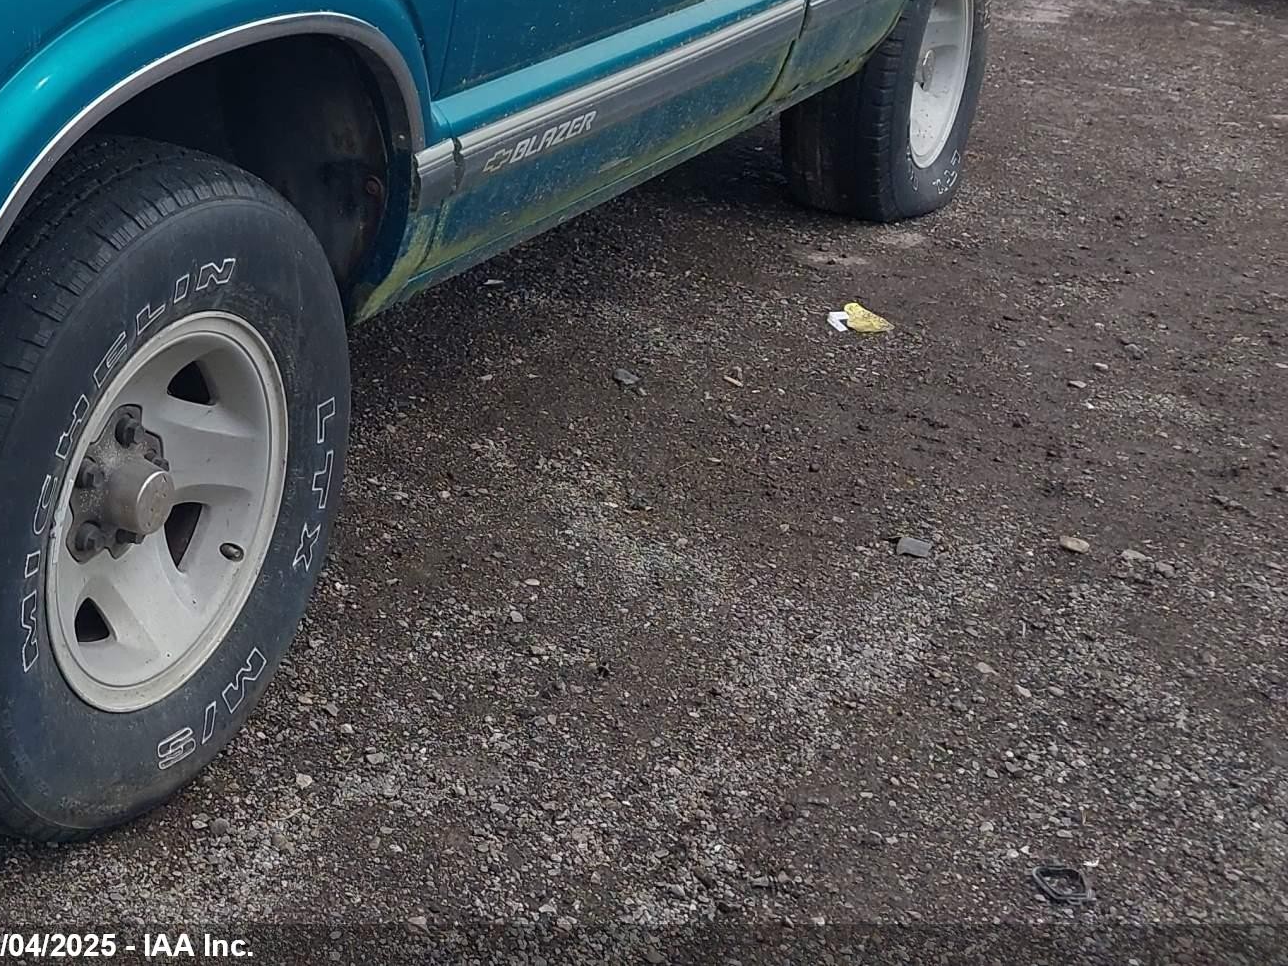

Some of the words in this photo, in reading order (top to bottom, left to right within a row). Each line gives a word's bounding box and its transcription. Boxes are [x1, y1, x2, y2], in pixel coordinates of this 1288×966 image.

[509, 110, 597, 164] BLAZER
[21, 257, 237, 674] MICHELIN
[292, 397, 337, 572] LTX
